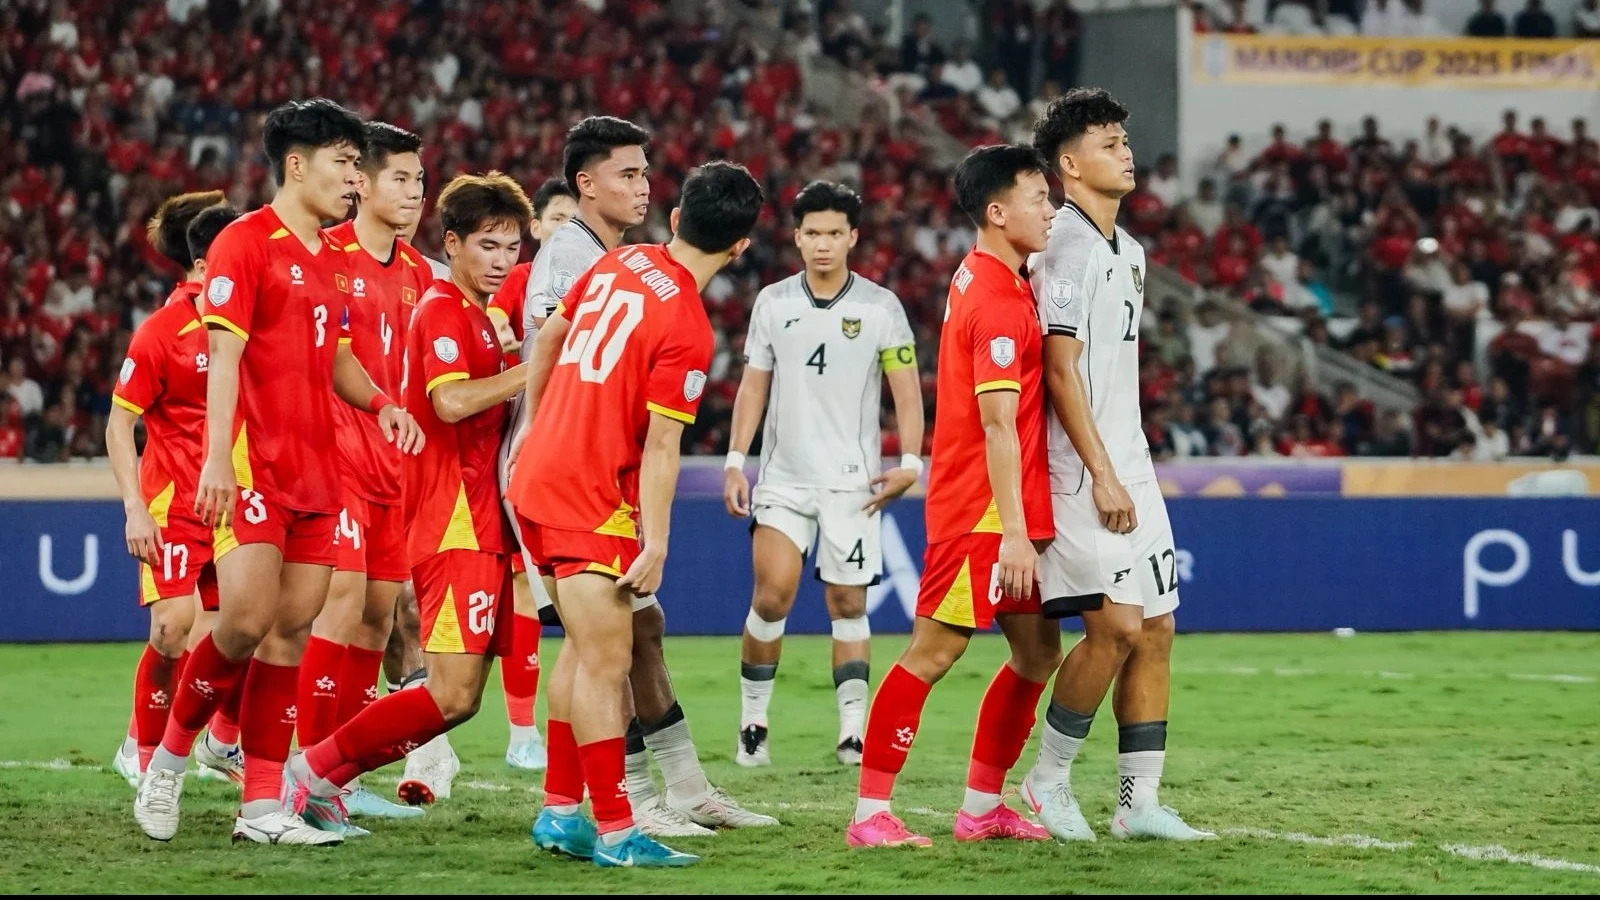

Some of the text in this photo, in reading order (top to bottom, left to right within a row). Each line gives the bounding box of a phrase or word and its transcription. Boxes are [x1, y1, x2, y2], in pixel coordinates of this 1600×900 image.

[1366, 47, 1427, 76] CUP
[313, 304, 328, 348] 3
[380, 312, 393, 356] 4
[558, 272, 645, 384] 20
[805, 342, 827, 375] 4
[896, 346, 913, 364] C
[240, 488, 268, 525] 3
[339, 507, 361, 550] 4
[163, 542, 189, 582] 17
[845, 538, 865, 569] 4
[1148, 548, 1178, 596] 12
